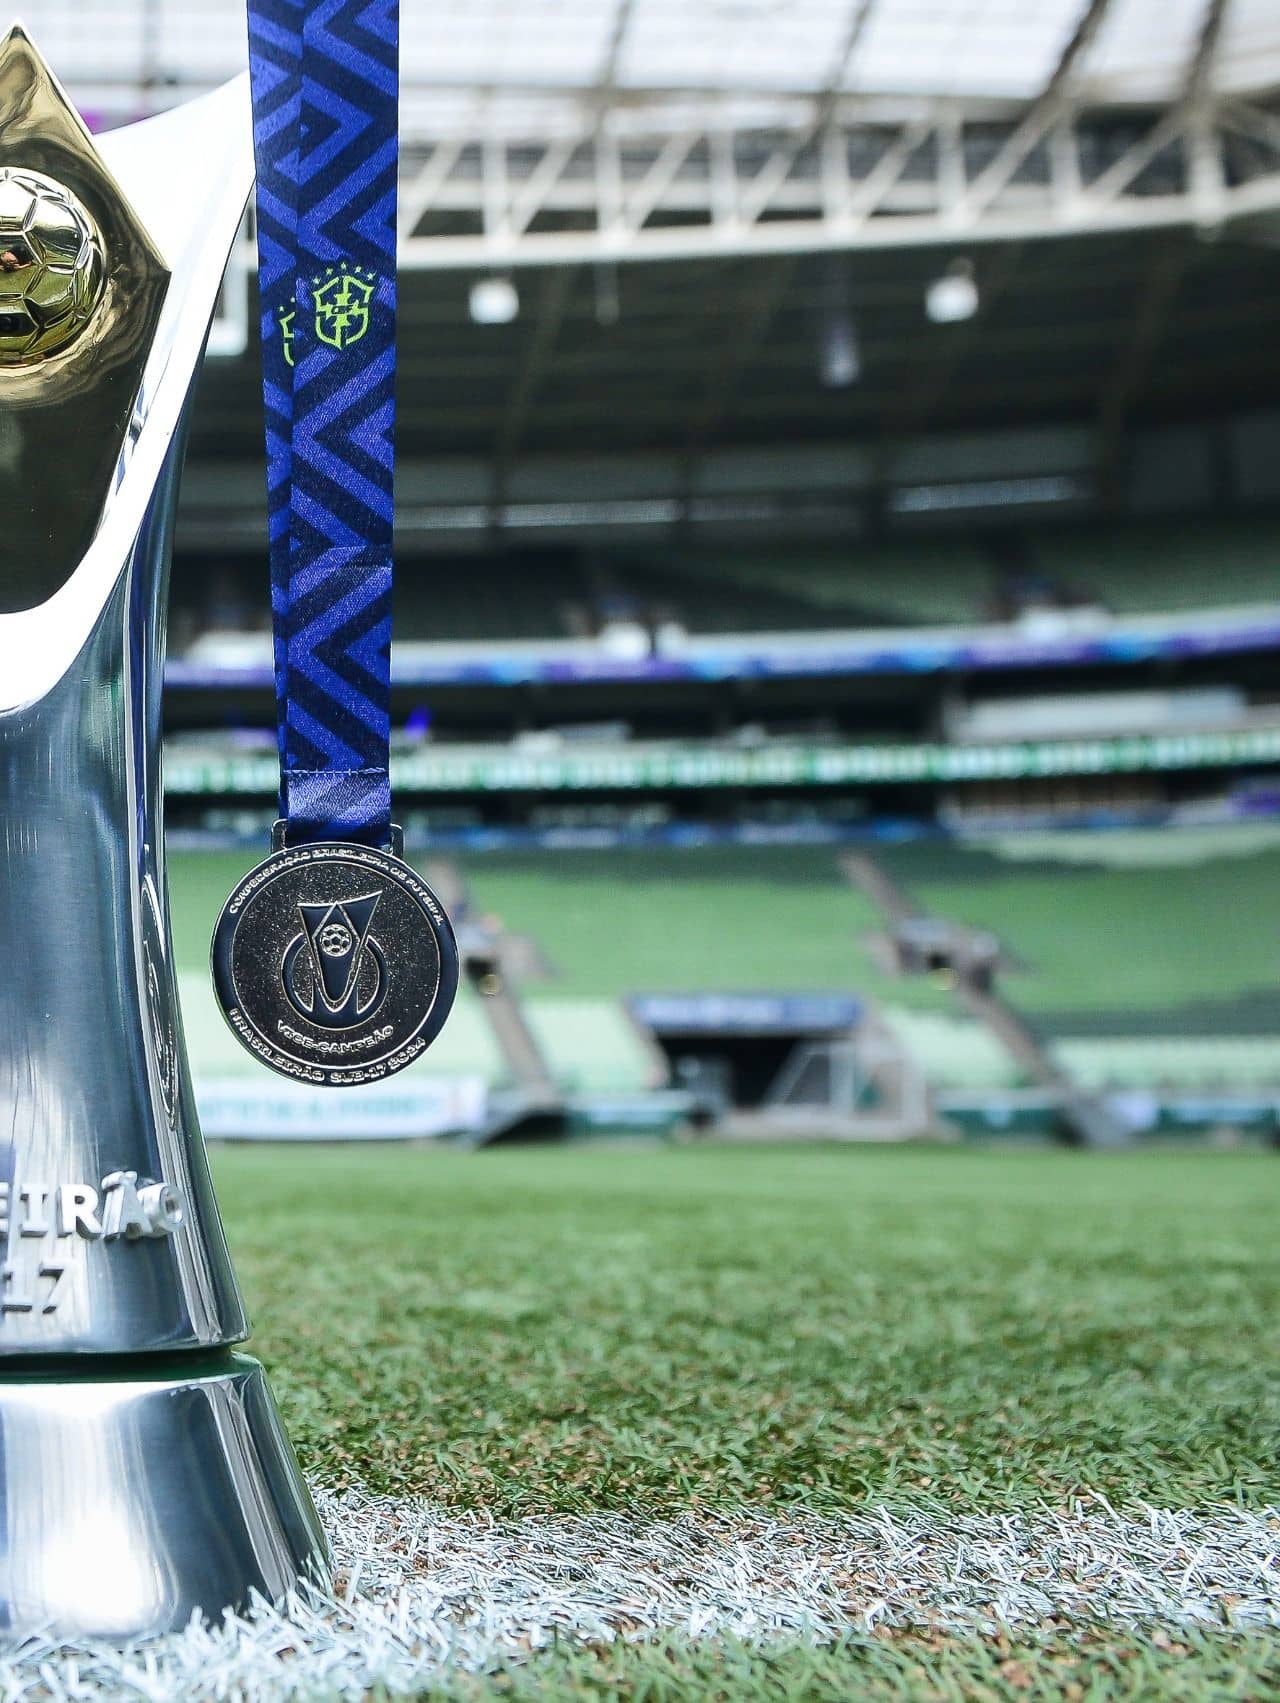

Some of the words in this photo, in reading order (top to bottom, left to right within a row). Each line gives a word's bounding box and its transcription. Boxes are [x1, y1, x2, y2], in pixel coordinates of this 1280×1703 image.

[229, 852, 311, 914] CONFEDERAÇÃO
[312, 848, 389, 870] BRASILEIRA
[390, 867, 408, 880] DE
[406, 878, 443, 926] FUTEBOL
[229, 1008, 325, 1081] BRASILEIRÃO
[330, 1063, 386, 1083] SUB-17
[388, 1037, 426, 1070] 2024
[278, 1019, 394, 1055] VICE-CAMPEÃO
[1, 1258, 79, 1314] 17
